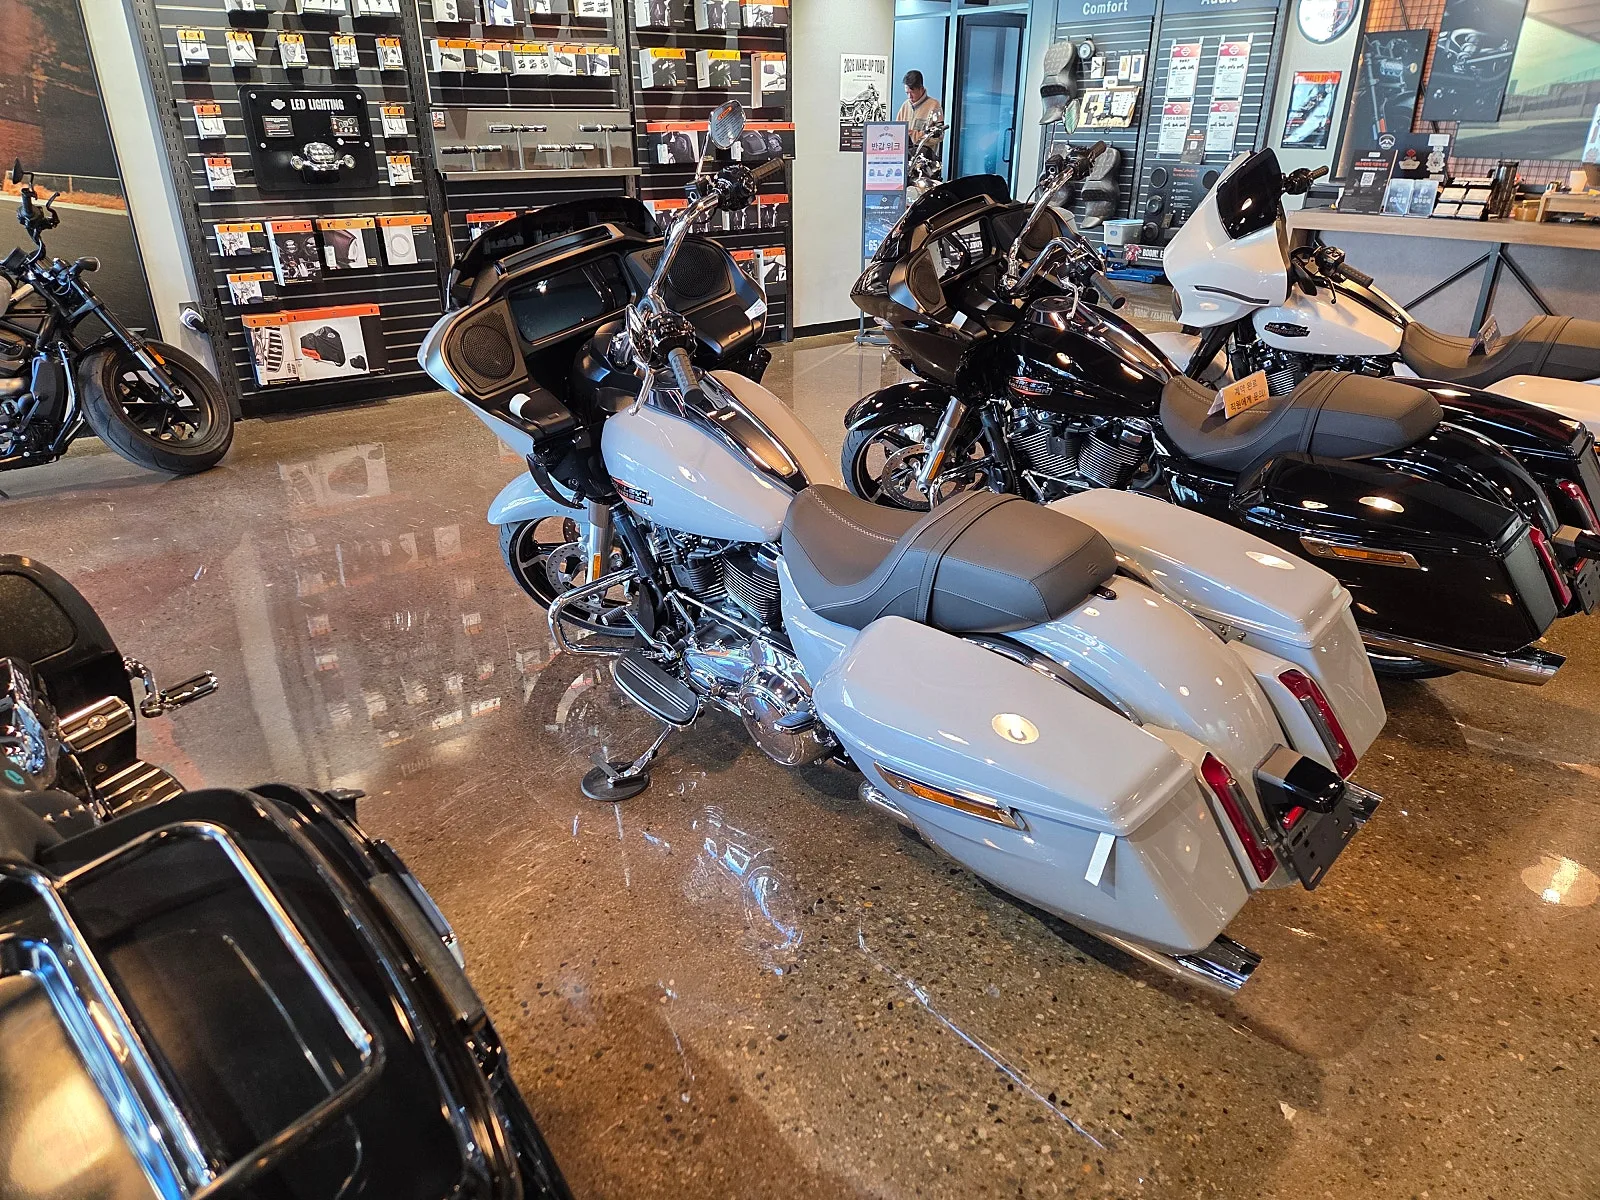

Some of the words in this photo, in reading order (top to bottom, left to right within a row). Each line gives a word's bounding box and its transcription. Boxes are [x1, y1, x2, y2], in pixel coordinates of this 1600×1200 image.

[1082, 0, 1128, 16] Comfort
[875, 60, 885, 74] TOUR
[290, 98, 306, 111] LED
[307, 98, 345, 111] LIGHTING
[887, 142, 901, 151] 위크
[1142, 248, 1159, 257] BOOM!
[1246, 379, 1258, 391] 완료
[1230, 394, 1252, 411] 직원에게
